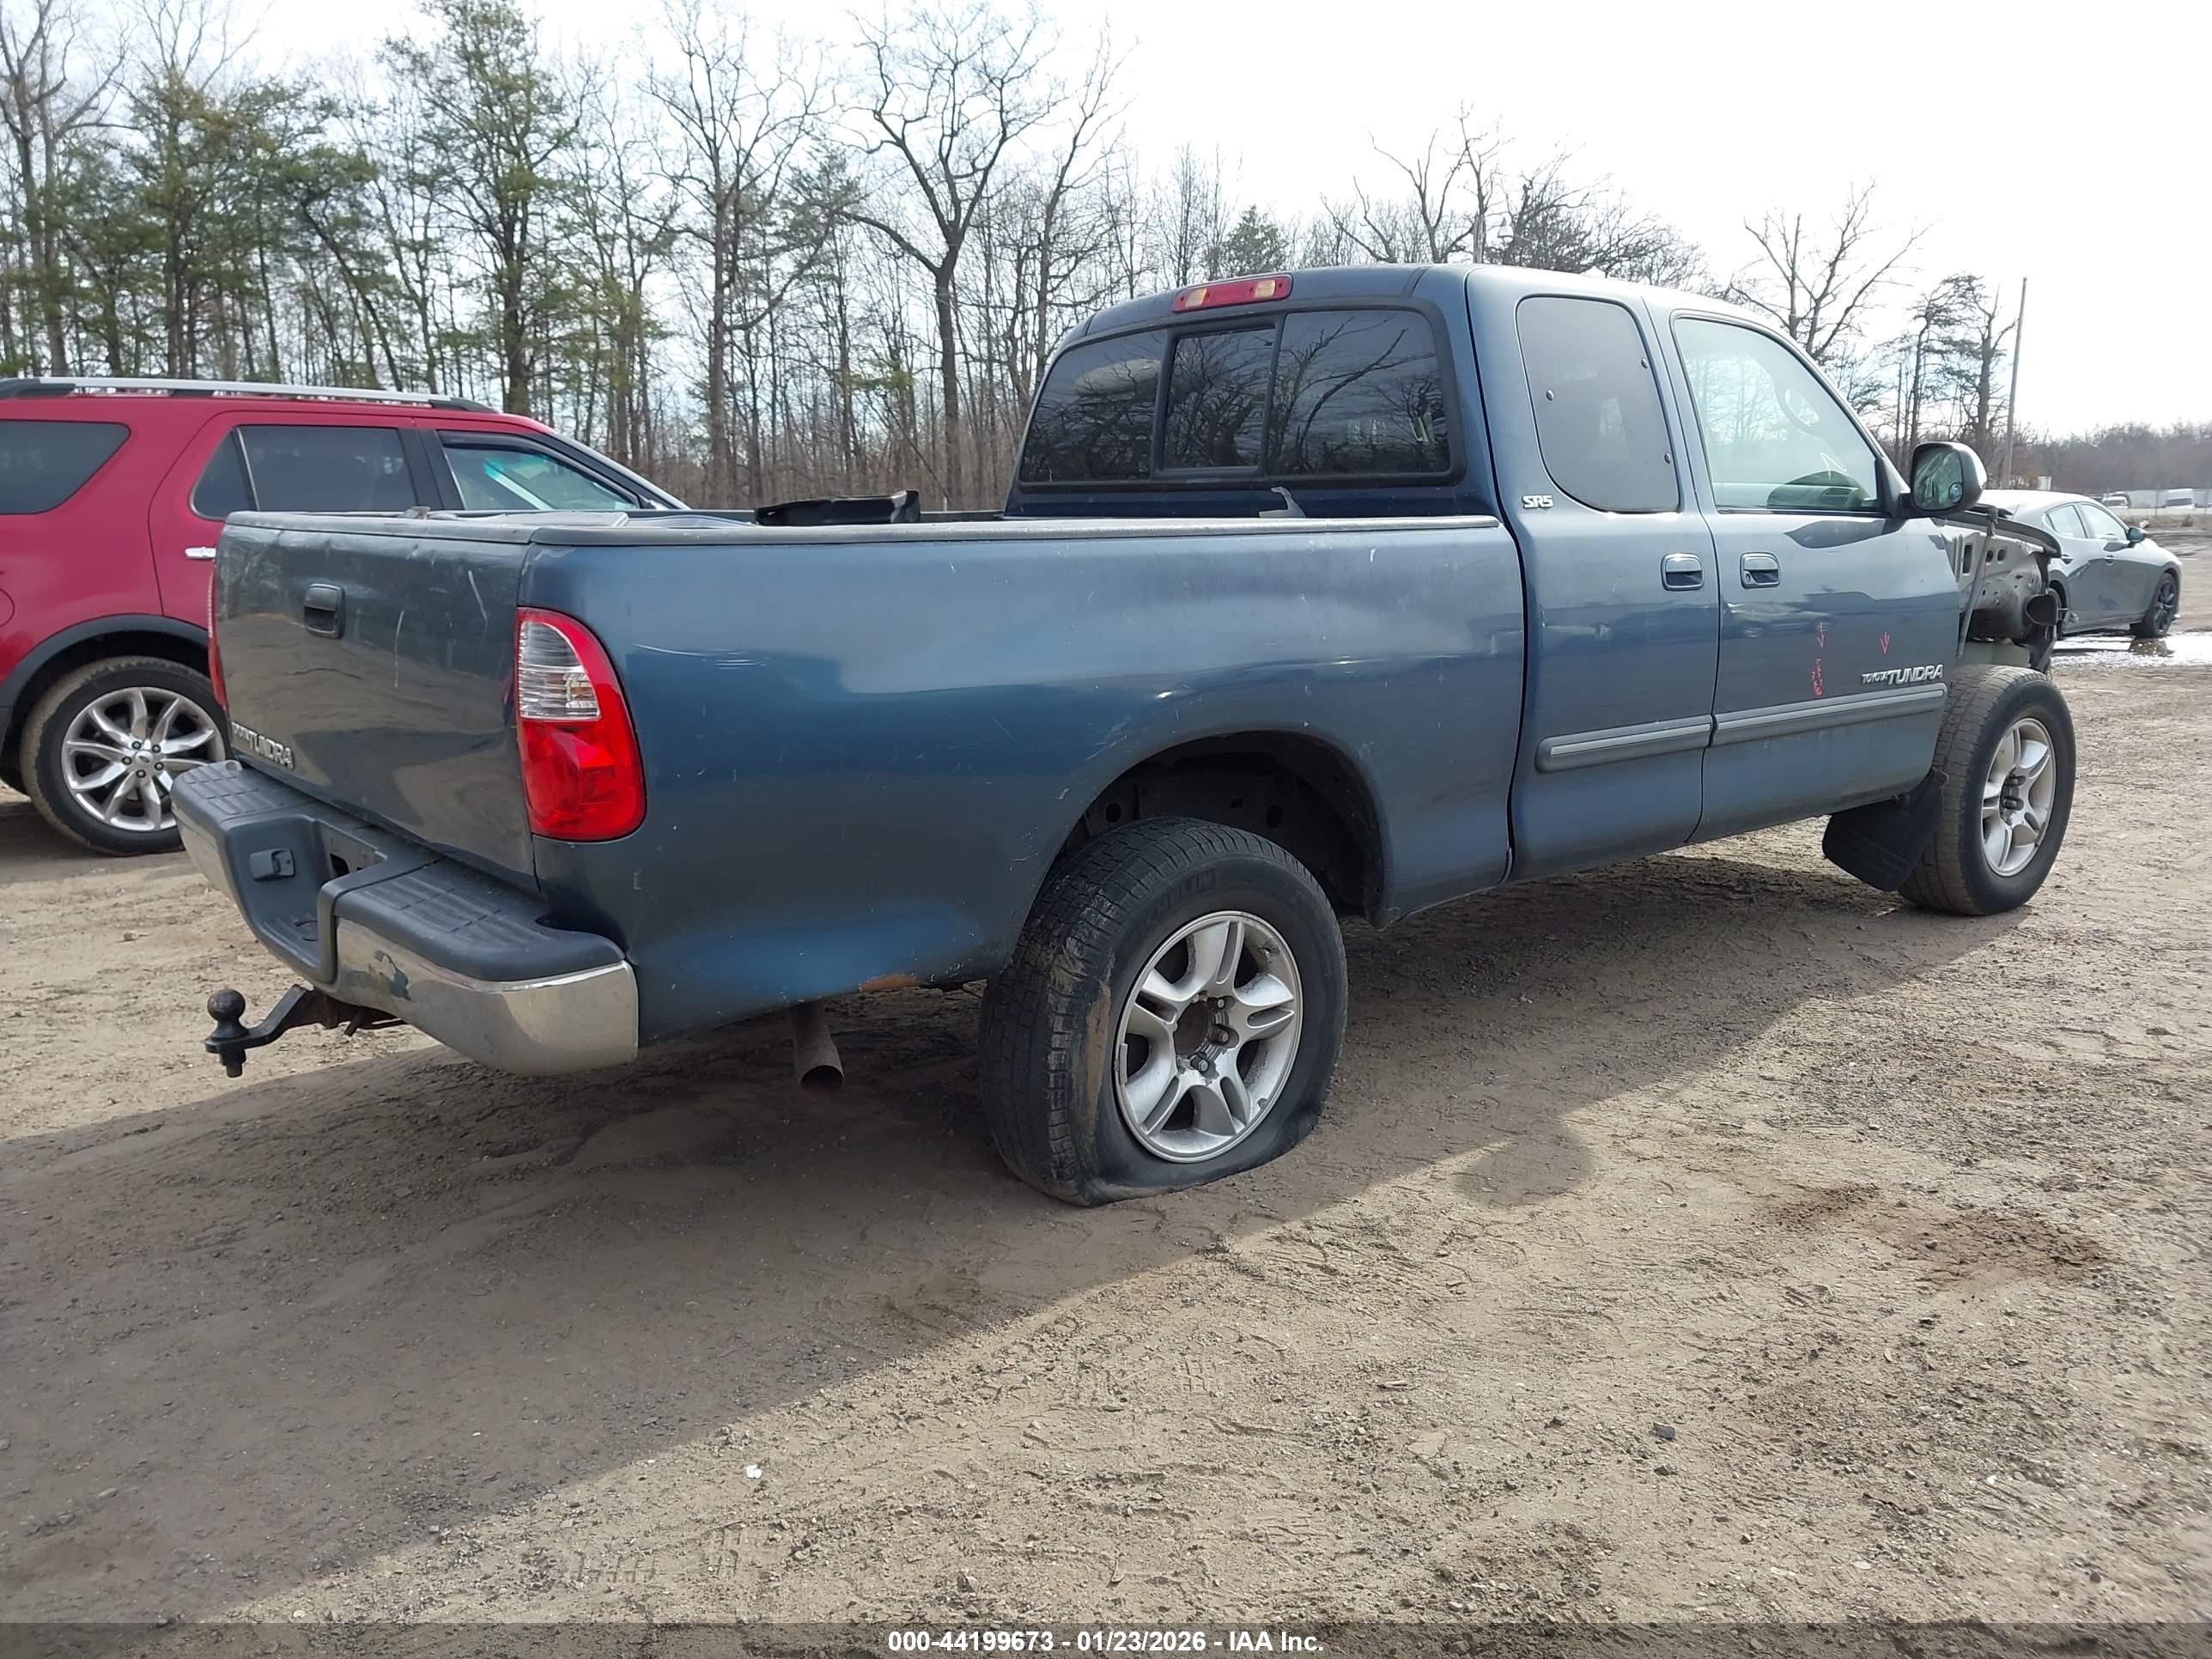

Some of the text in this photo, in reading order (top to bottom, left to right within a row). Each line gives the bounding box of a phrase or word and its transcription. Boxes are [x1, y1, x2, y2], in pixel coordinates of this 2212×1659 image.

[1522, 495, 1553, 508] SR5
[1887, 664, 1943, 685] TUNDRA
[247, 730, 294, 769] TUNDRA
